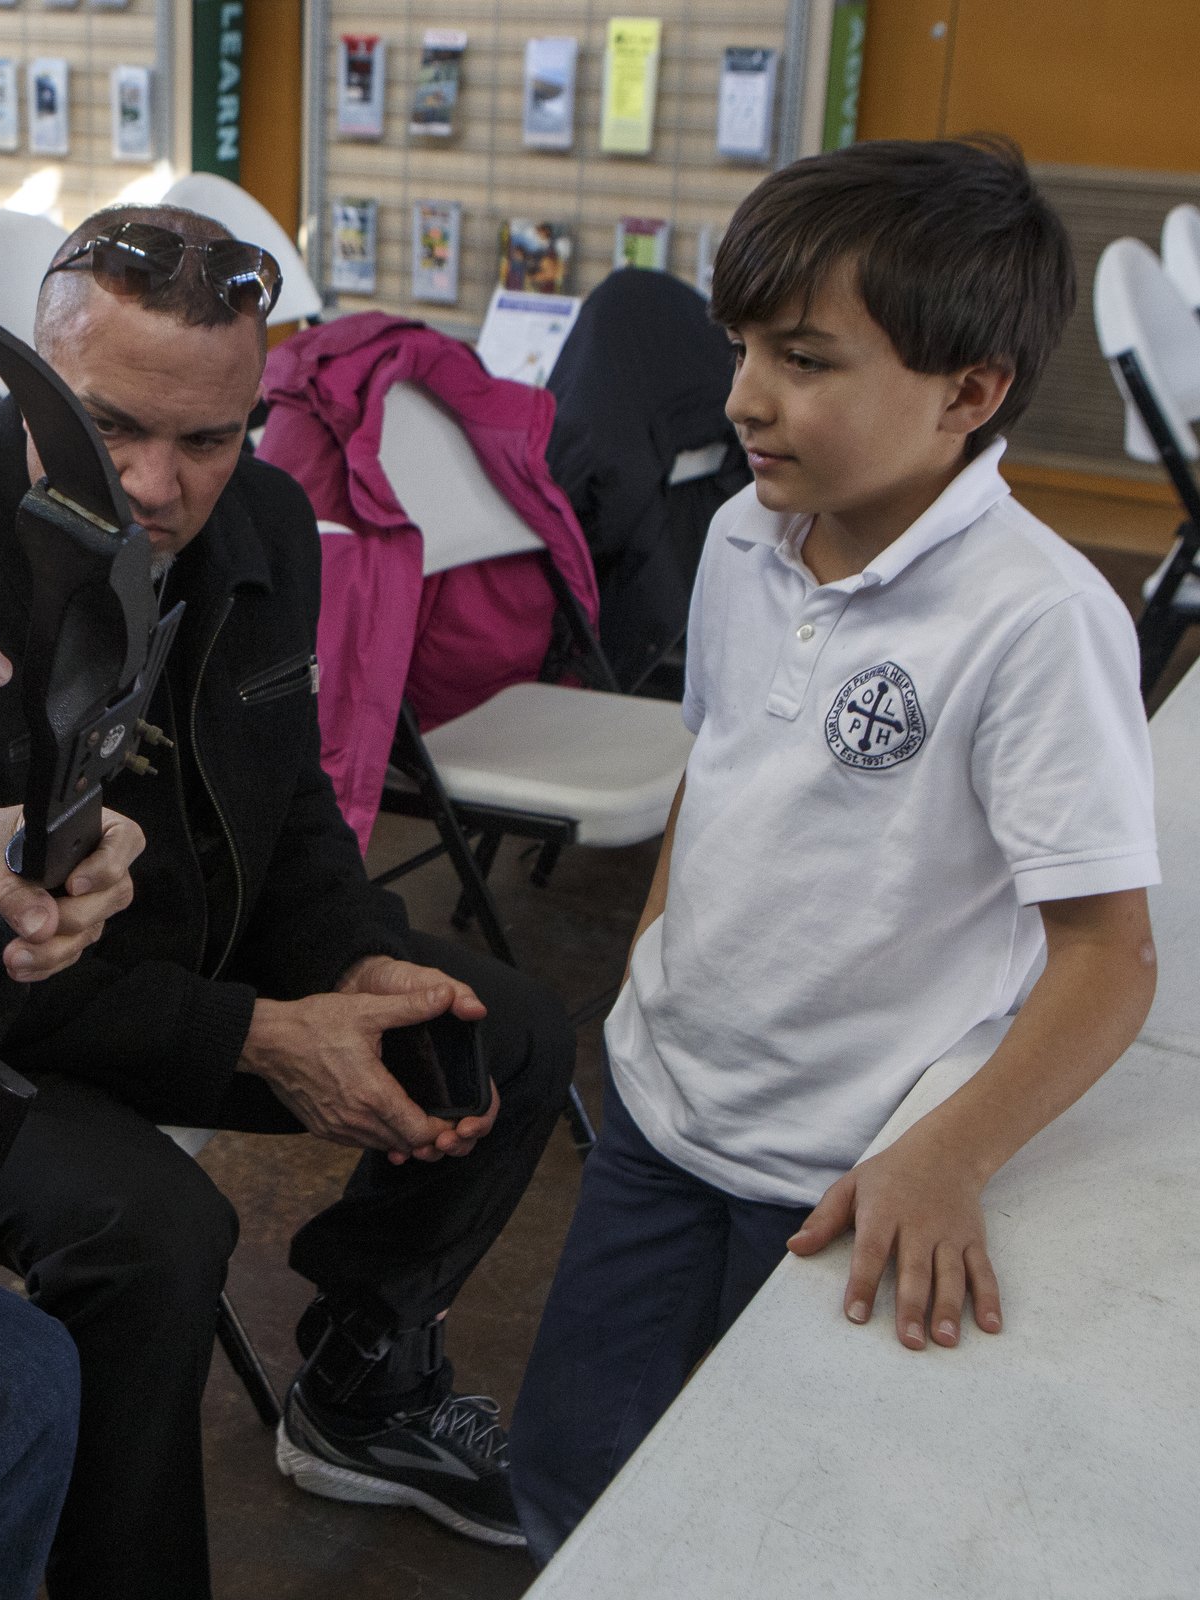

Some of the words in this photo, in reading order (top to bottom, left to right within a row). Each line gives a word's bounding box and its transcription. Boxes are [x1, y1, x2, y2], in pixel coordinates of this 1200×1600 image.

[216, 2, 243, 161] LEARN
[889, 666, 910, 691] HELP
[843, 686, 853, 698] OF
[861, 689, 874, 705] O
[884, 697, 896, 717] L
[829, 697, 847, 721] LADY
[829, 721, 839, 743] OUR
[848, 718, 861, 733] P
[875, 727, 891, 745] H
[839, 748, 858, 764] Est.
[862, 756, 884, 766] 1937
[891, 734, 922, 760] SCHOOL
